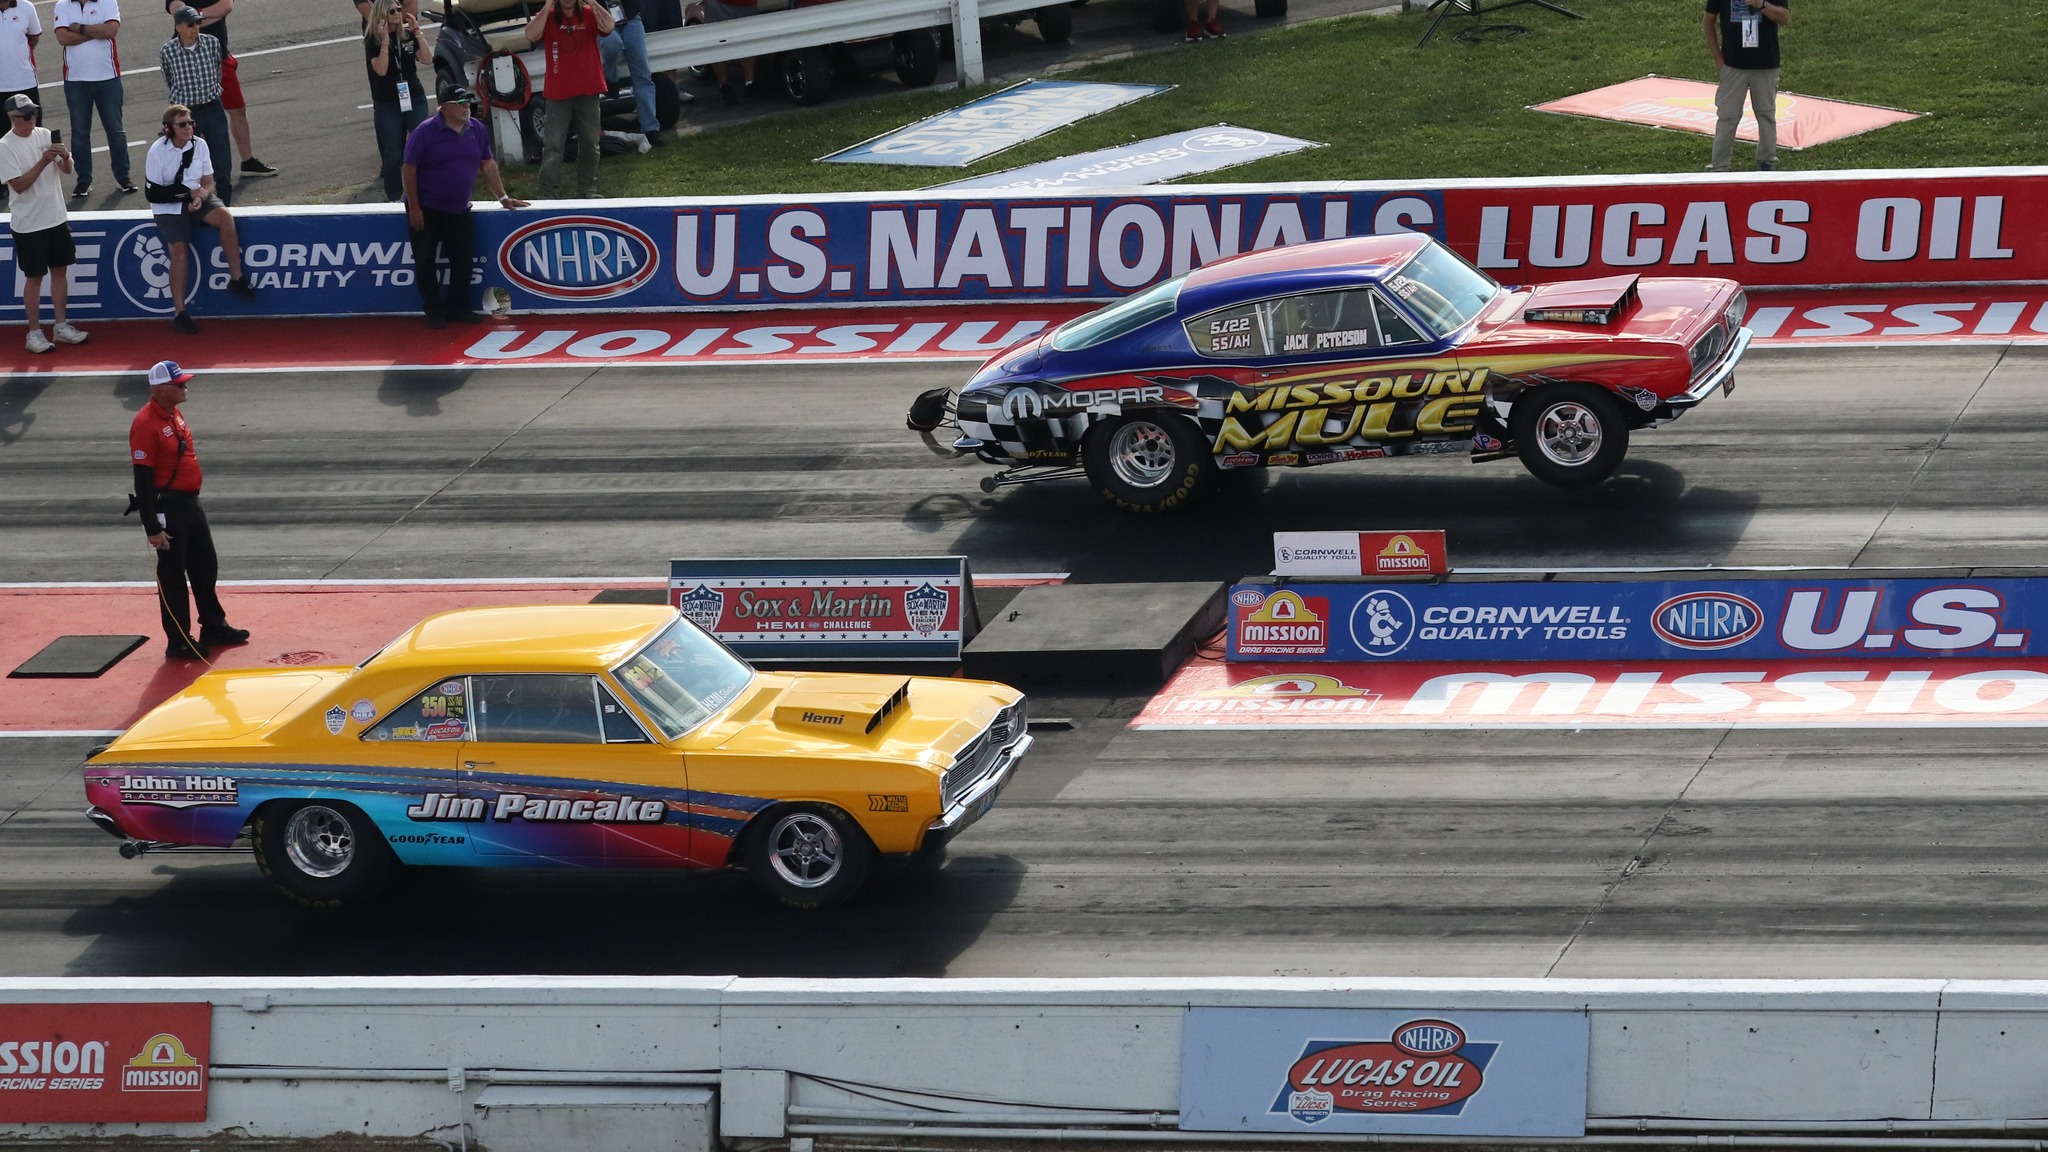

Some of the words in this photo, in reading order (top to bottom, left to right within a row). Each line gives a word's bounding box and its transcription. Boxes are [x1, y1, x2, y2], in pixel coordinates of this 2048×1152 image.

[1477, 199, 1810, 268] LUCAS
[1855, 195, 2013, 260] OIL
[524, 230, 638, 283] NHRA
[1543, 311, 1584, 322] HEMI
[1210, 317, 1251, 335] 5/22
[1212, 334, 1251, 351] SS/AH
[1283, 333, 1309, 351] JACK
[1316, 329, 1368, 349] PETERSON
[1043, 386, 1164, 409] MOPAR
[1226, 368, 1489, 413] MISSOURI
[1212, 394, 1486, 453] MULE
[735, 590, 784, 619] Sox
[787, 598, 802, 617] &
[807, 590, 892, 618] Martin
[1236, 594, 1261, 605] NHRA
[1423, 606, 1624, 624] CORNWELL
[1669, 601, 1748, 637] NHRA
[1781, 588, 2025, 650] U.S.
[757, 621, 805, 630] HEMI
[823, 620, 872, 629] CHALLENGE
[1419, 627, 1534, 640] QUALITY
[1543, 626, 1628, 640] TOOLS
[421, 696, 447, 718] 350
[702, 691, 726, 712] HEMI
[352, 711, 375, 719] IHRA
[801, 712, 845, 725] Hemi
[450, 726, 461, 734] OIL
[120, 775, 177, 790] John
[185, 775, 237, 791] Holt
[407, 793, 484, 821] Jim
[494, 794, 665, 822] Pancake
[1404, 1028, 1454, 1051] NHRA
[1300, 1059, 1414, 1087] LUCAS
[1412, 1060, 1464, 1087] OIL
[49, 1078, 104, 1090] SERIES
[1341, 1089, 1384, 1099] Drag
[1390, 1089, 1450, 1100] Racing
[1362, 1099, 1418, 1108] Series
[1295, 1101, 1327, 1110] LUCAS
